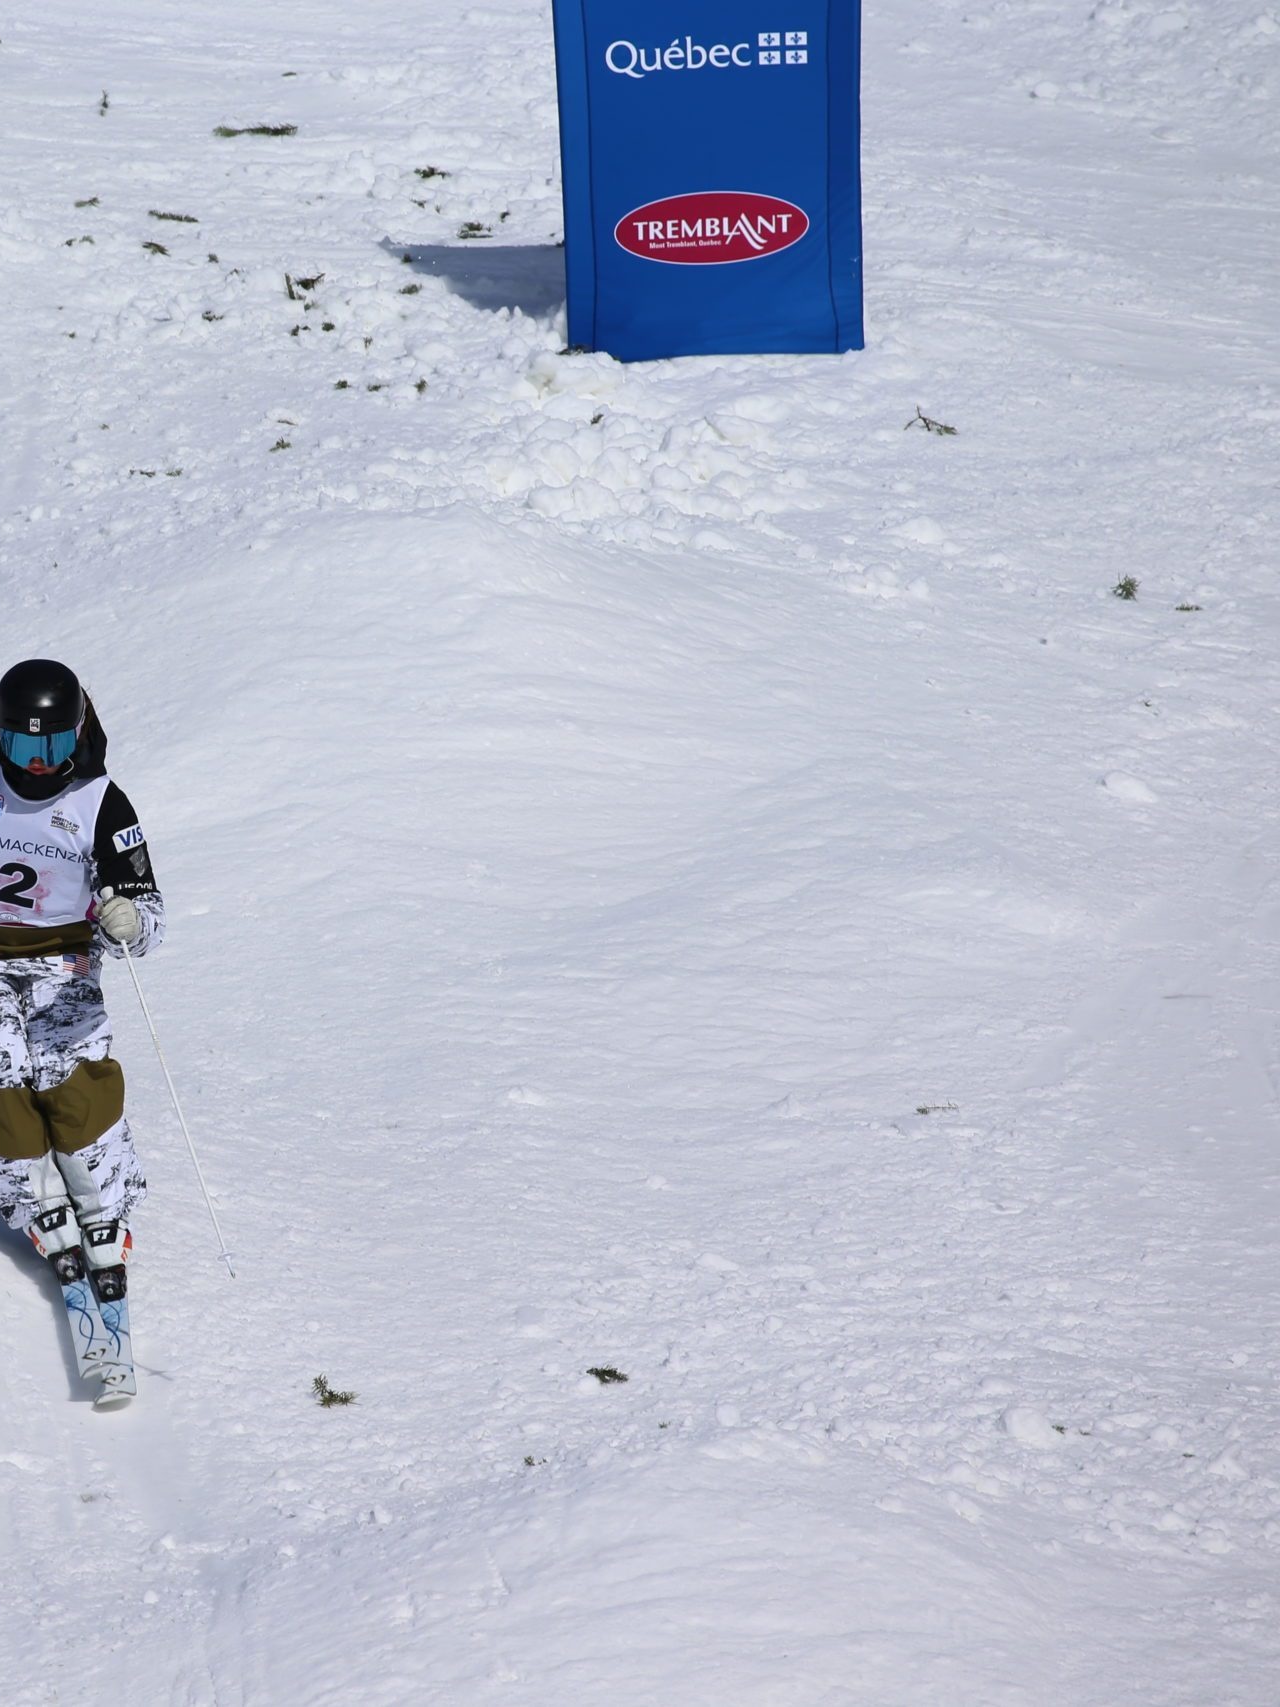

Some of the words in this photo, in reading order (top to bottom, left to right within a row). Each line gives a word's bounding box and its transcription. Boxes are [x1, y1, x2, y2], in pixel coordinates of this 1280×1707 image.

[605, 35, 752, 78] Québec
[632, 213, 793, 251] TREMBLANT
[114, 826, 143, 847] VIS
